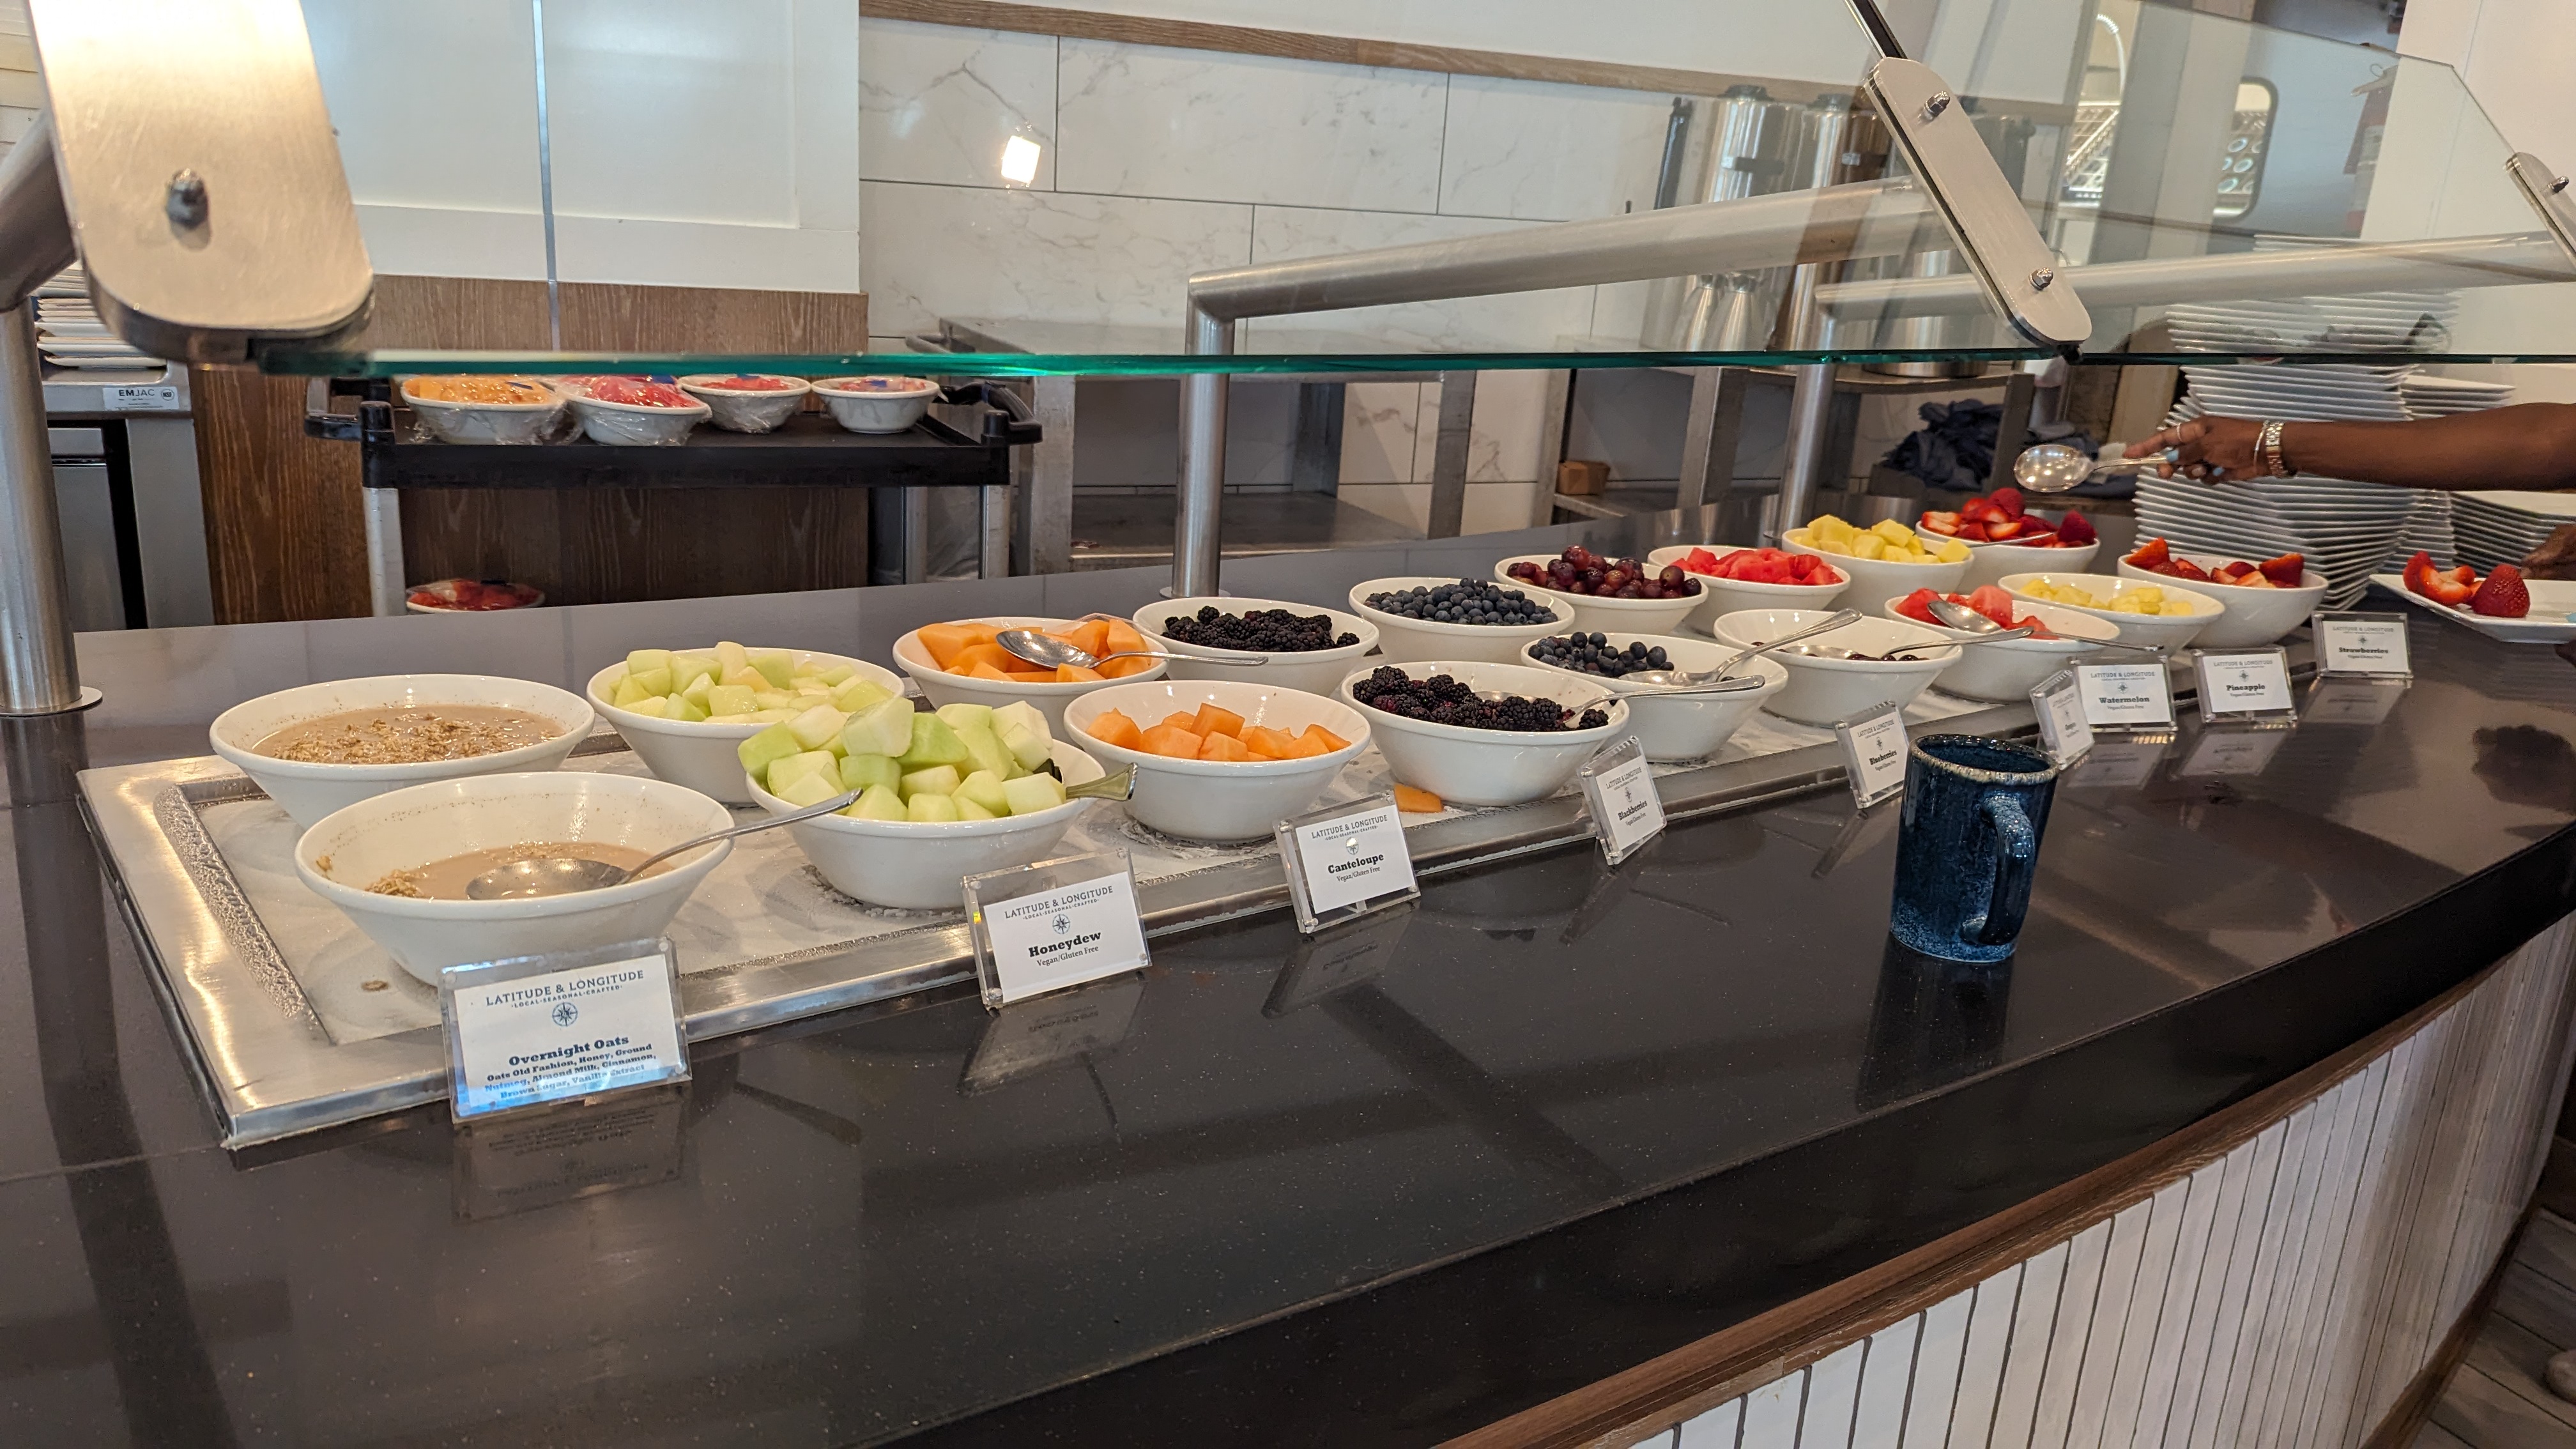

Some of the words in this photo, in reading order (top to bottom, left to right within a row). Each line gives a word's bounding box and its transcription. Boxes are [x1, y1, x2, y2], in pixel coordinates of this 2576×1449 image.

[1869, 750, 1897, 765] Blueberries
[1618, 801, 1648, 820] Blackberries
[1311, 825, 1344, 839] LATITUDE
[1351, 815, 1388, 829] LONGITUDE
[1328, 854, 1384, 873] Canteloupe
[1004, 901, 1050, 919] LATITUDE
[1061, 885, 1113, 905] LONGITUDE
[1028, 932, 1101, 957] Honeydew
[1084, 946, 1099, 954] Free
[486, 986, 551, 1006] LATITUDE
[556, 984, 565, 993] &
[569, 970, 644, 991] LONGITUDE
[509, 1043, 590, 1066] Overnight
[594, 1036, 629, 1049] Oats
[513, 1068, 530, 1076] Old
[533, 1060, 577, 1073] Fashion,
[579, 1053, 613, 1063] Honey,
[615, 1043, 652, 1056] Ground
[533, 1069, 572, 1082] Almond
[602, 1054, 656, 1068] Cinnamon,
[500, 1087, 535, 1098] Brown
